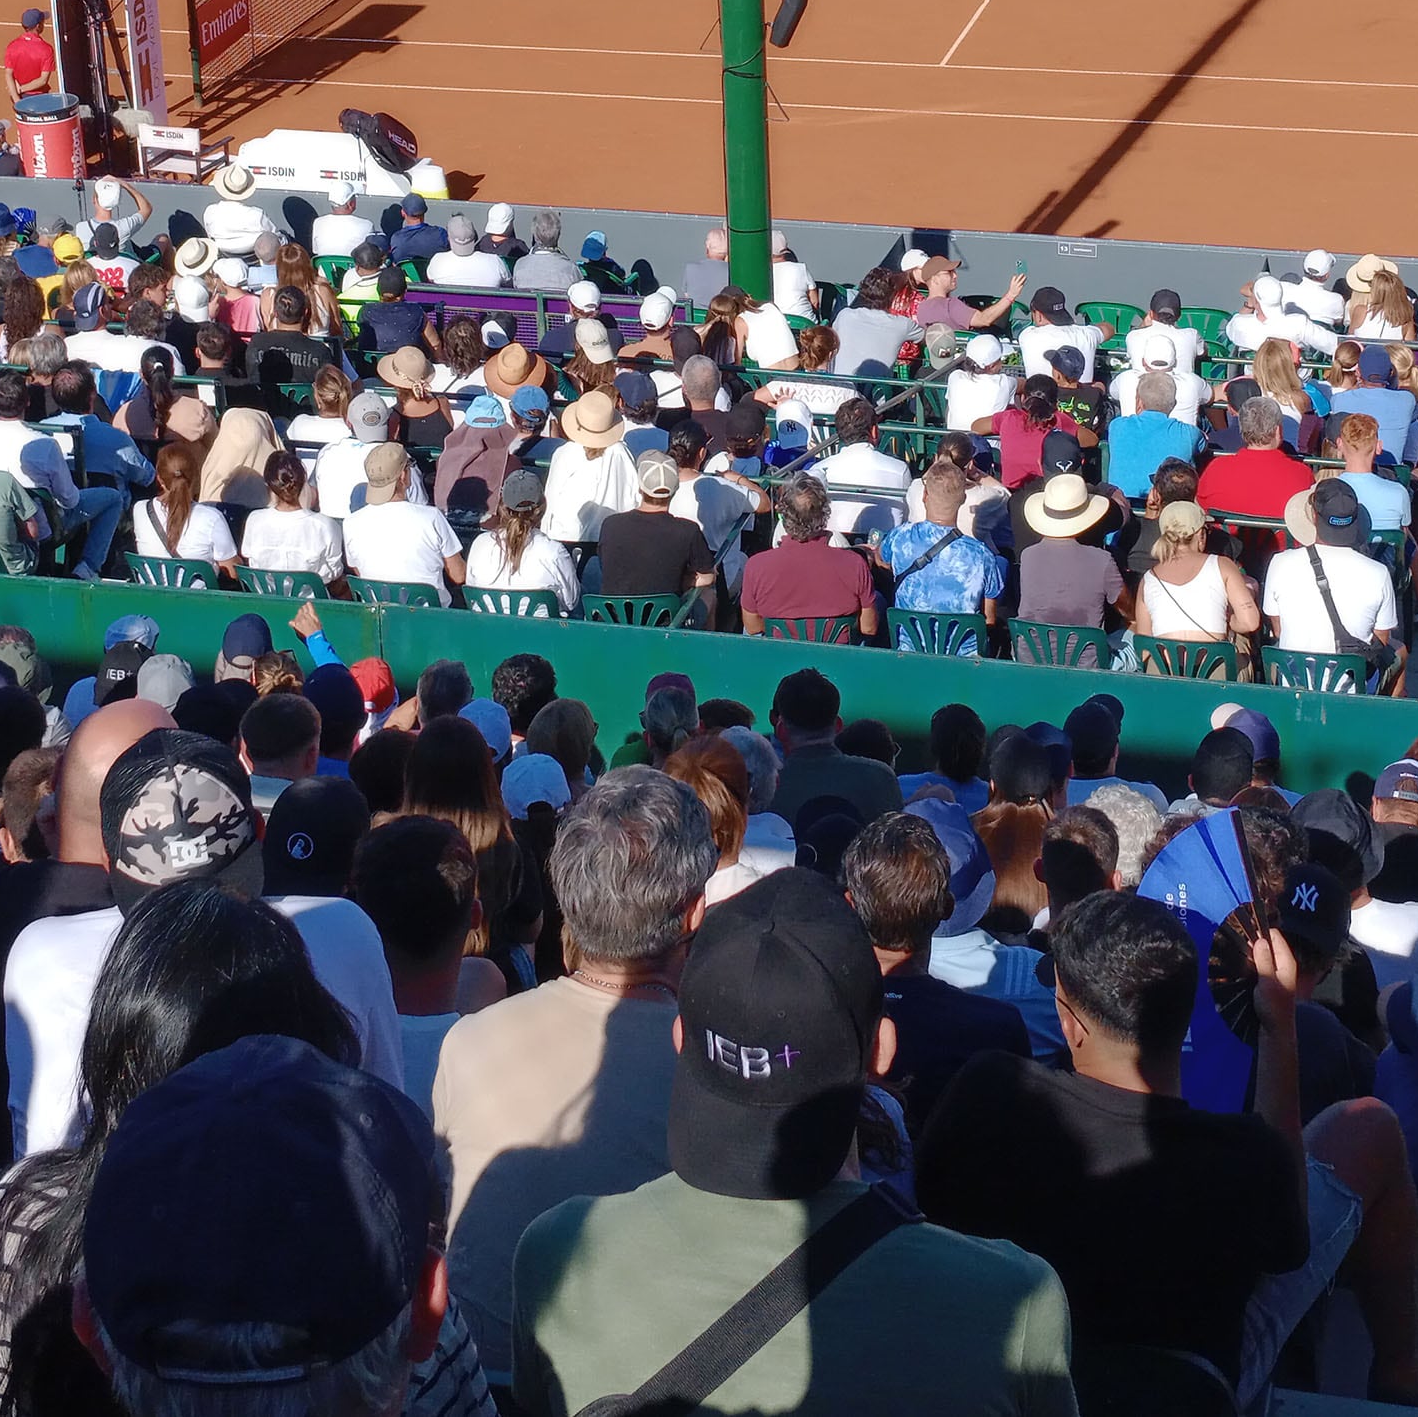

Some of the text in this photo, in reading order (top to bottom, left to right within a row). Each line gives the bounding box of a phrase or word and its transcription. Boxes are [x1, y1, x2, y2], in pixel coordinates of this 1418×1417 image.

[388, 131, 417, 154] HEAD
[268, 166, 295, 177] ISDIN
[106, 669, 133, 680] IEB+
[169, 834, 209, 869] DC
[1165, 892, 1174, 911] de
[1291, 882, 1319, 912] NY
[706, 1029, 801, 1079] IEB+
